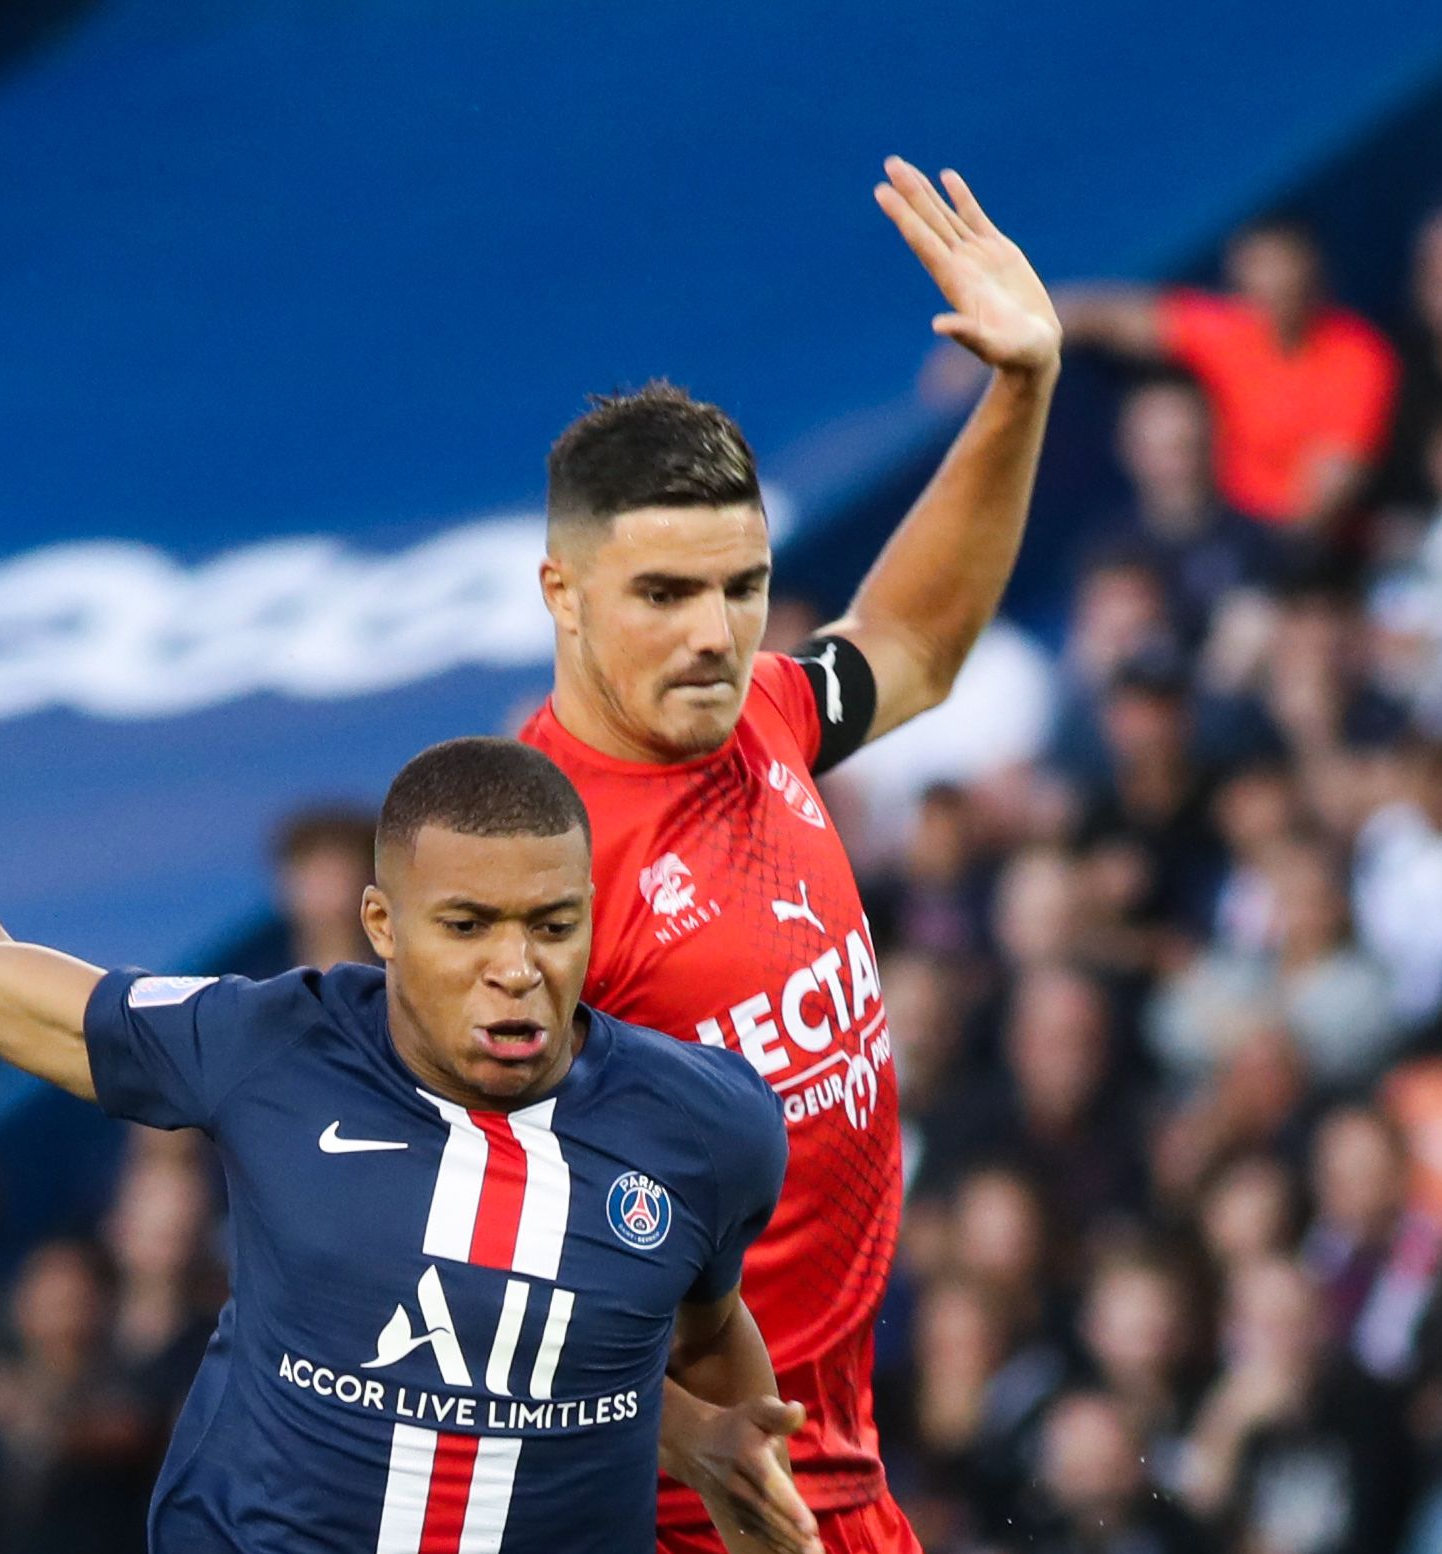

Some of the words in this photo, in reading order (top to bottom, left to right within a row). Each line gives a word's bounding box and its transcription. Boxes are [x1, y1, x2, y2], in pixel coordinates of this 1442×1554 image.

[619, 1175, 662, 1199] PARIS
[279, 1353, 386, 1412] ACCOR
[396, 1387, 475, 1426] LIVE
[488, 1390, 639, 1430] LIMITLESS
